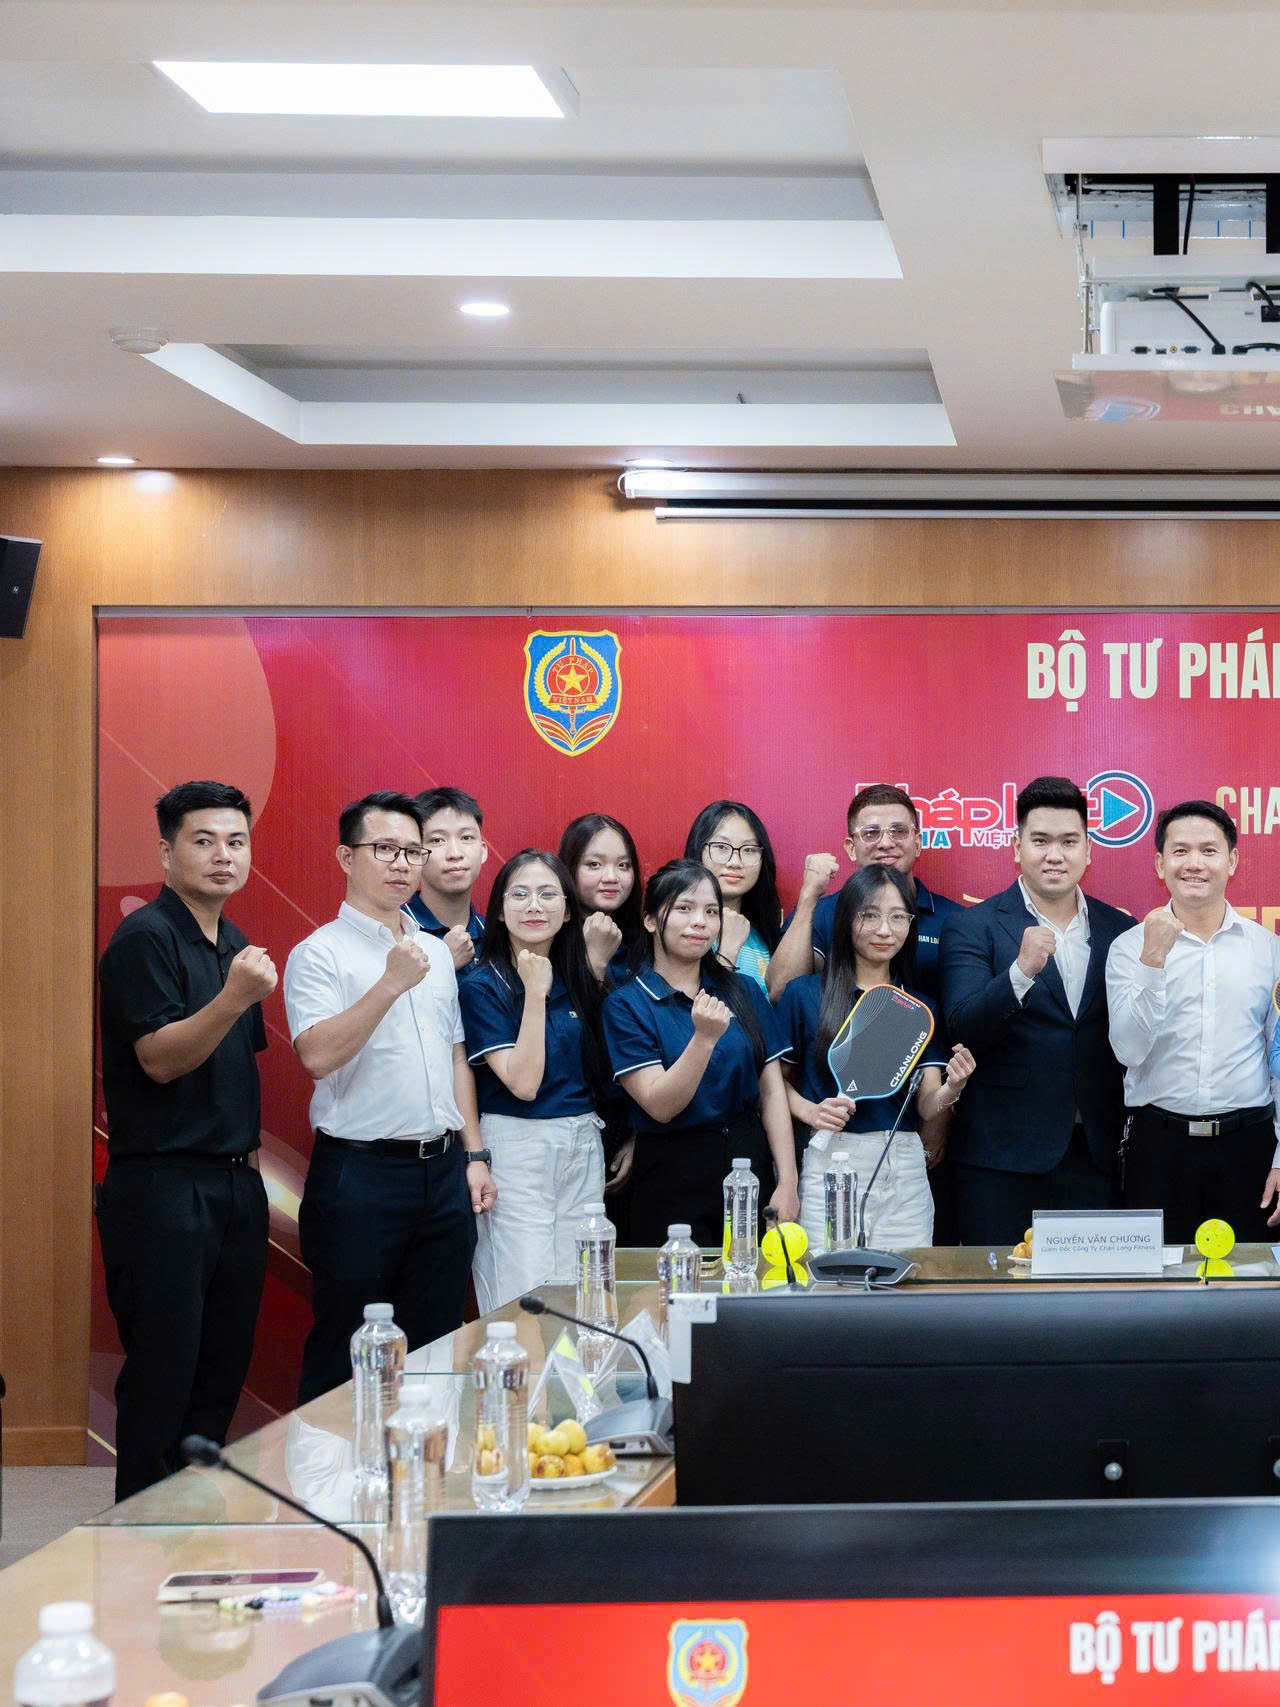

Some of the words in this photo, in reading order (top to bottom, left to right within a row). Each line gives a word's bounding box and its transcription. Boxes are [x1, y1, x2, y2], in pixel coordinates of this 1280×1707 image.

[1027, 629, 1087, 712] BỘ
[1103, 638, 1163, 699] TƯ
[972, 828, 1015, 850] VIỆT
[890, 1030, 928, 1088] CHANLONG
[1110, 1234, 1151, 1243] CHƯƠNG
[1069, 1610, 1122, 1685] BỘ
[1131, 1617, 1184, 1674] TƯ
